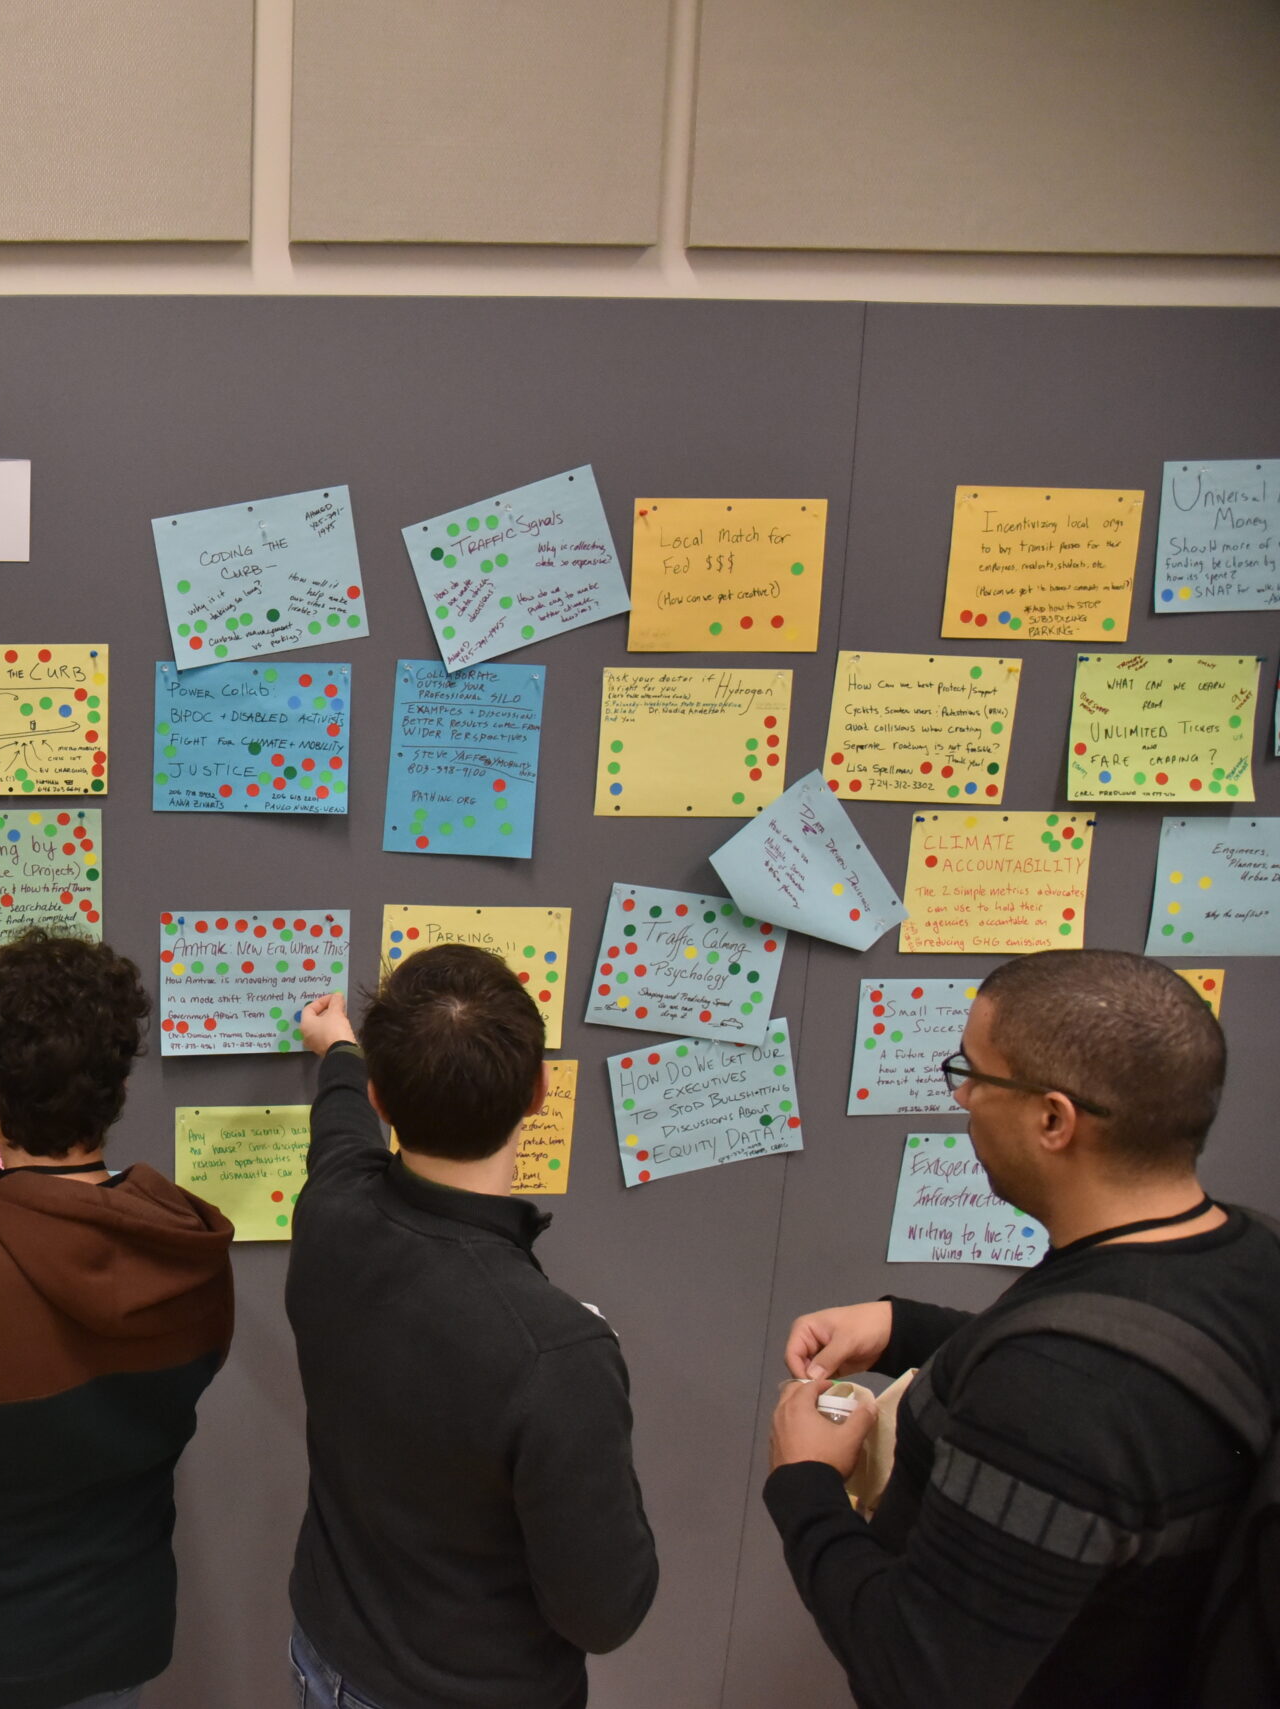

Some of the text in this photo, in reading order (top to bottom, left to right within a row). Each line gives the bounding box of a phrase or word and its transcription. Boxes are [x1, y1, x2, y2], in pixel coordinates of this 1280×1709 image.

[982, 511, 1089, 532] Incentivizing local
[1214, 507, 1267, 532] Money
[451, 511, 564, 556] TRAFFIC Signals
[660, 526, 791, 548] Local Match for
[199, 538, 288, 566] CODING THE
[982, 541, 1054, 553] to transit
[1170, 537, 1271, 555] Should more of
[663, 552, 734, 574] Fed $$$
[1166, 555, 1275, 572] funding be chosen by
[1195, 585, 1232, 598] SNAP
[7, 669, 24, 678] THE
[30, 663, 86, 681] CURB
[848, 673, 872, 690] How
[1107, 678, 1185, 690] WHAT CAN WE
[491, 694, 521, 703] SILO
[632, 675, 655, 686] your
[659, 674, 693, 682] doctor
[702, 674, 715, 682] if
[714, 672, 773, 715] Hydrogen
[171, 708, 288, 724] BIPOC DISABLED
[171, 733, 207, 747] FIGHT
[1090, 722, 1168, 743] UNLIMITED
[169, 762, 257, 778] JUSTICE
[1091, 756, 1130, 768] FARE
[31, 835, 57, 860] by
[924, 834, 1016, 850] CLIMATE
[942, 857, 1086, 874] ACCOUNTABILITY
[915, 884, 1029, 899] The 2 simple metrics
[927, 900, 1043, 913] can use to hold their
[426, 924, 494, 944] PARKING
[642, 921, 694, 962] Traffic
[973, 937, 1000, 946] GHG
[237, 942, 262, 955] New
[165, 976, 182, 984] How
[650, 961, 729, 990] Psychology
[884, 1000, 927, 1017] Small
[620, 1047, 784, 1097] HOW DO WE GET OUR
[663, 1070, 747, 1100] EXECUTIVES
[630, 1102, 704, 1125] TO STOP
[739, 1104, 770, 1119] ABOUT
[652, 1136, 716, 1164] EQUITY
[961, 1224, 975, 1244] to
[971, 1243, 982, 1258] to
